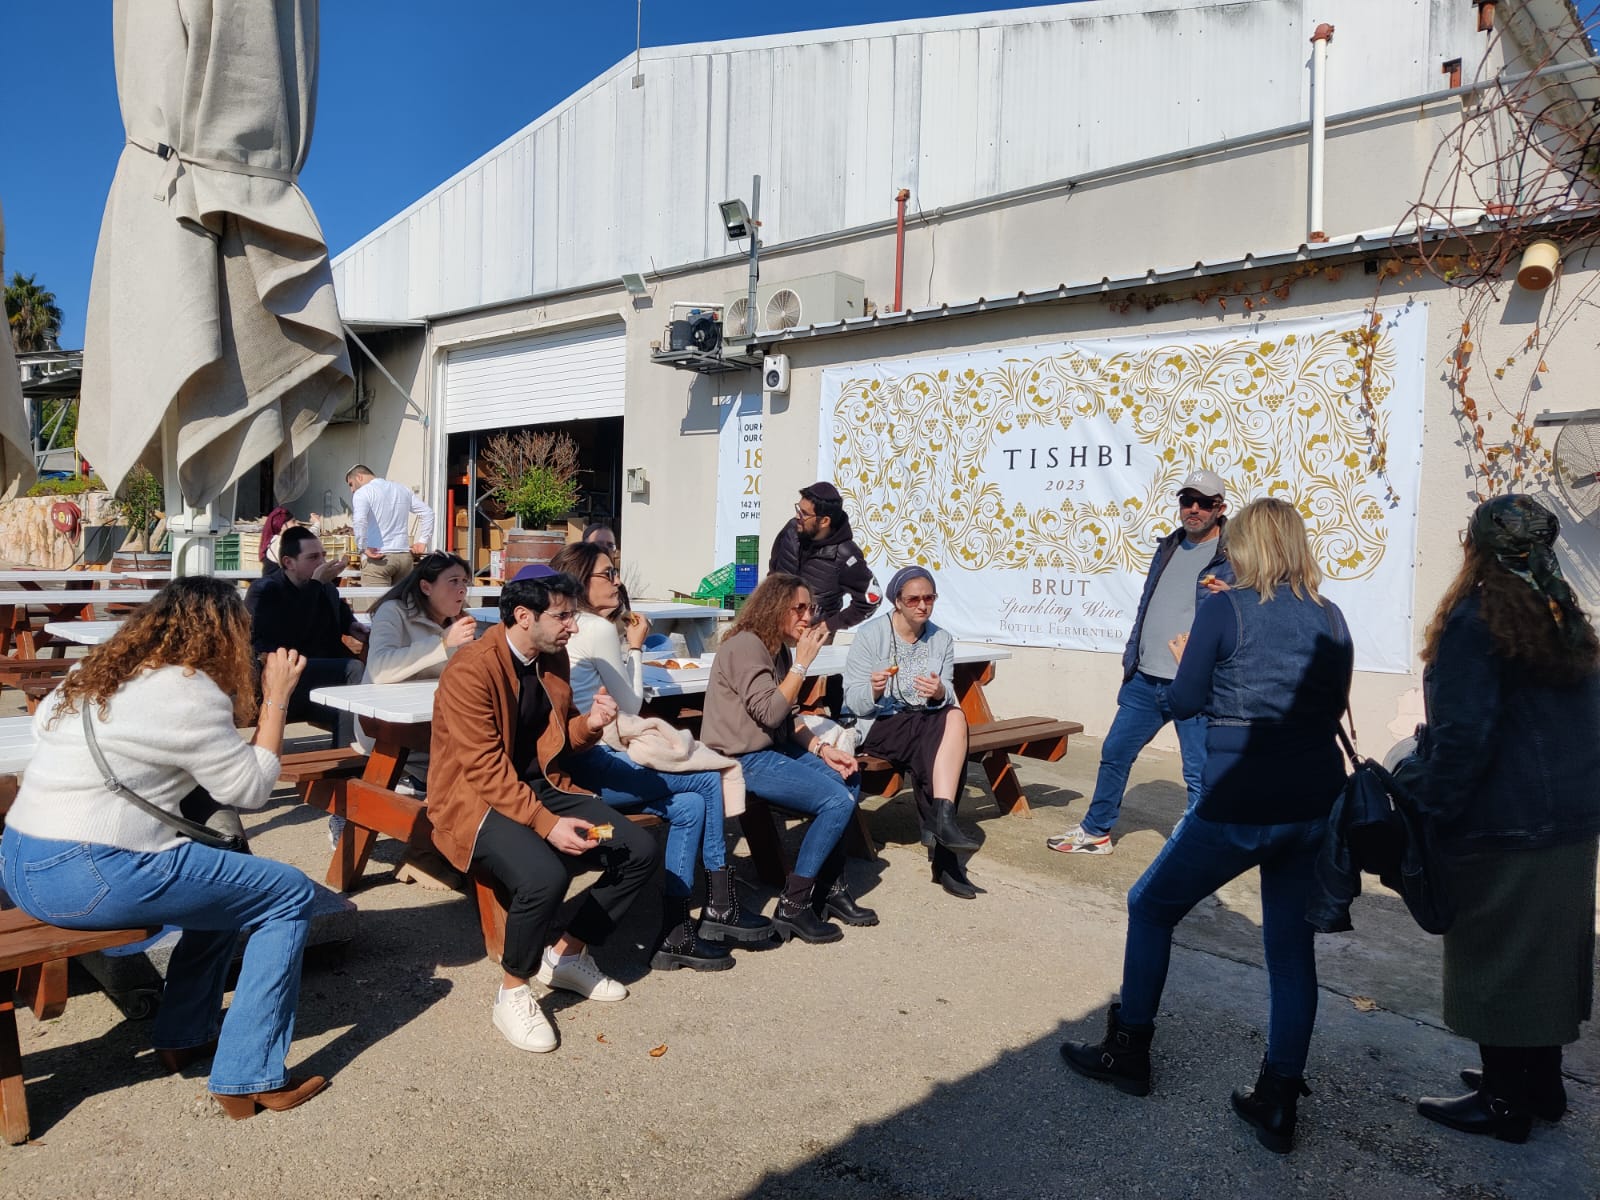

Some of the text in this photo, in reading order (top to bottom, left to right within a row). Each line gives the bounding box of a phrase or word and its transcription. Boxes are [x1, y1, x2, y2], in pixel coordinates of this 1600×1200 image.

[744, 423, 758, 432] OUR
[743, 434, 758, 442] OUR
[1003, 444, 1132, 471] TISHBI
[1045, 479, 1086, 492] 2023
[740, 500, 752, 509] 142
[740, 511, 750, 519] OF
[1032, 578, 1091, 597] BRUT
[998, 597, 1124, 622] Sparkling Wine
